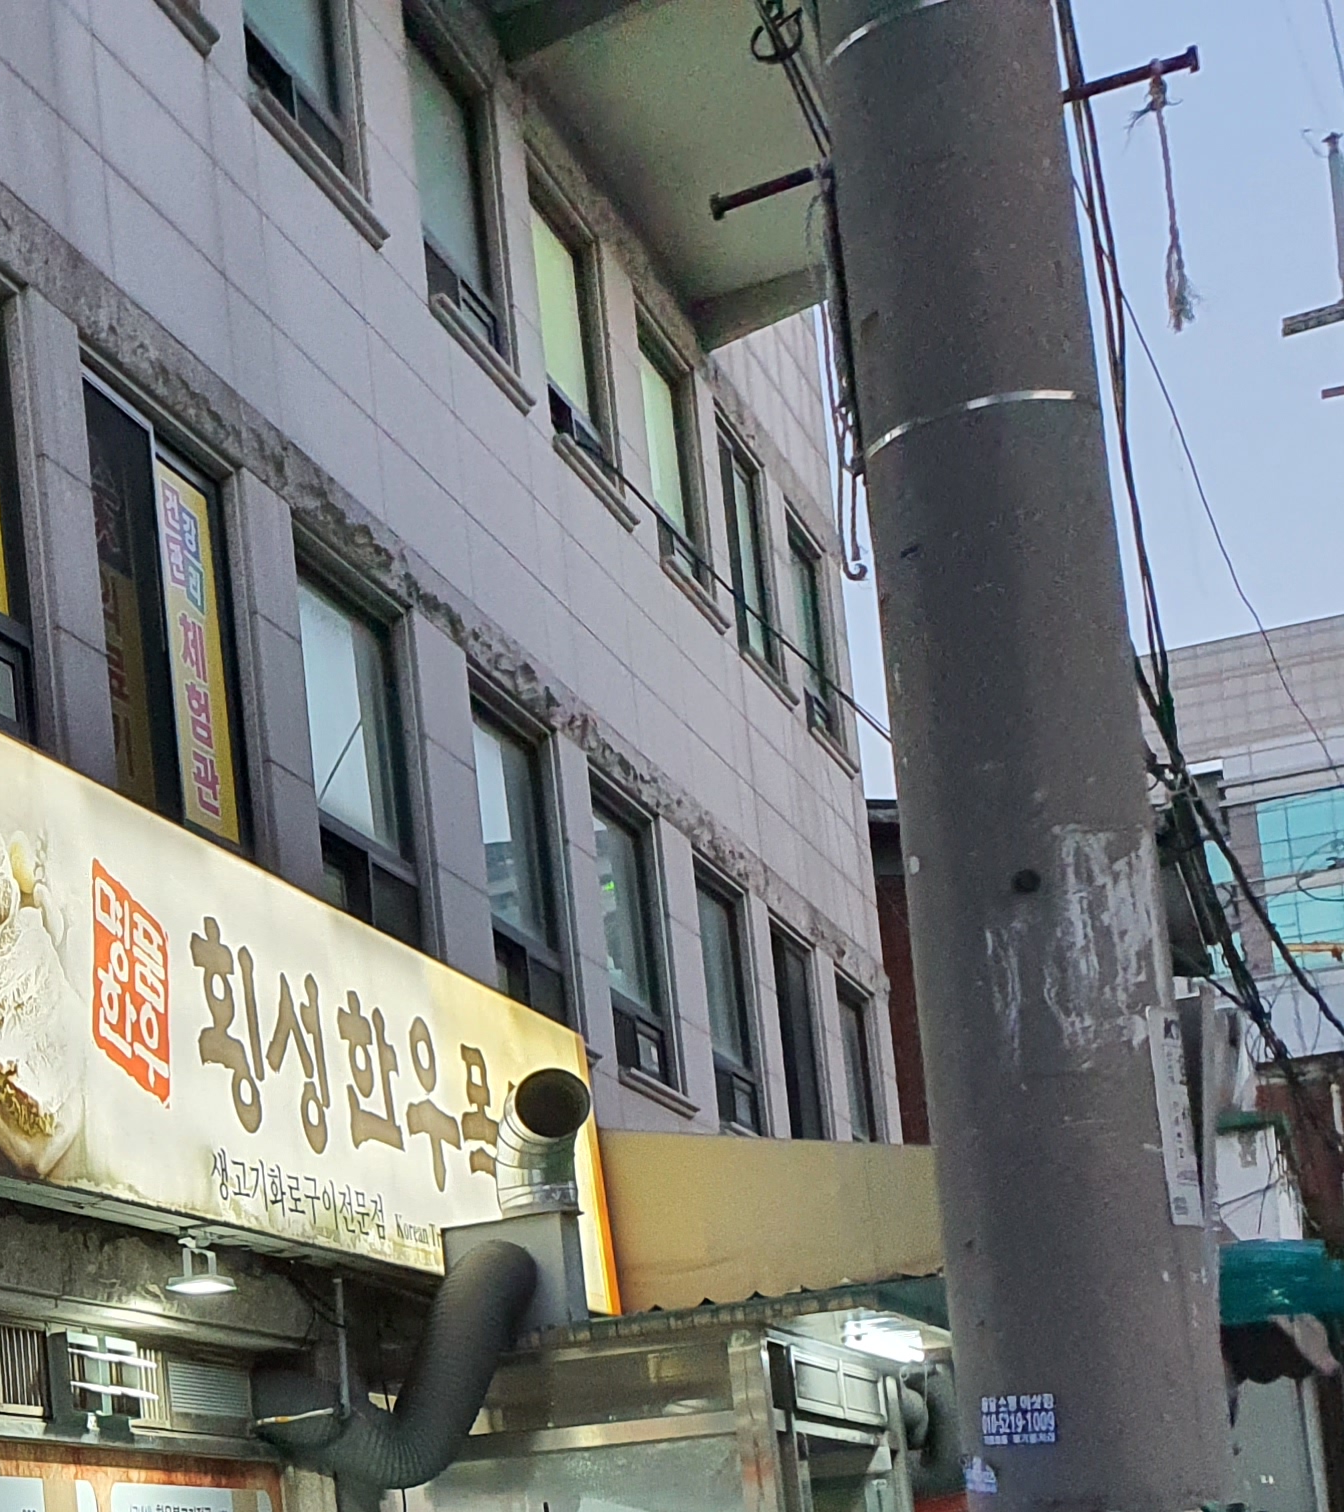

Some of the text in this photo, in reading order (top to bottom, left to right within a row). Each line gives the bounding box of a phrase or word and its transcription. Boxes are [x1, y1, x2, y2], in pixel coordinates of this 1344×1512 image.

[178, 611, 222, 819] 체험관
[93, 875, 166, 1015] 명품
[97, 962, 171, 1089] 한우
[189, 915, 515, 1193] 횡성 한우목
[210, 1147, 387, 1241] 생고기화로구이전문점
[394, 1213, 429, 1243] Korean
